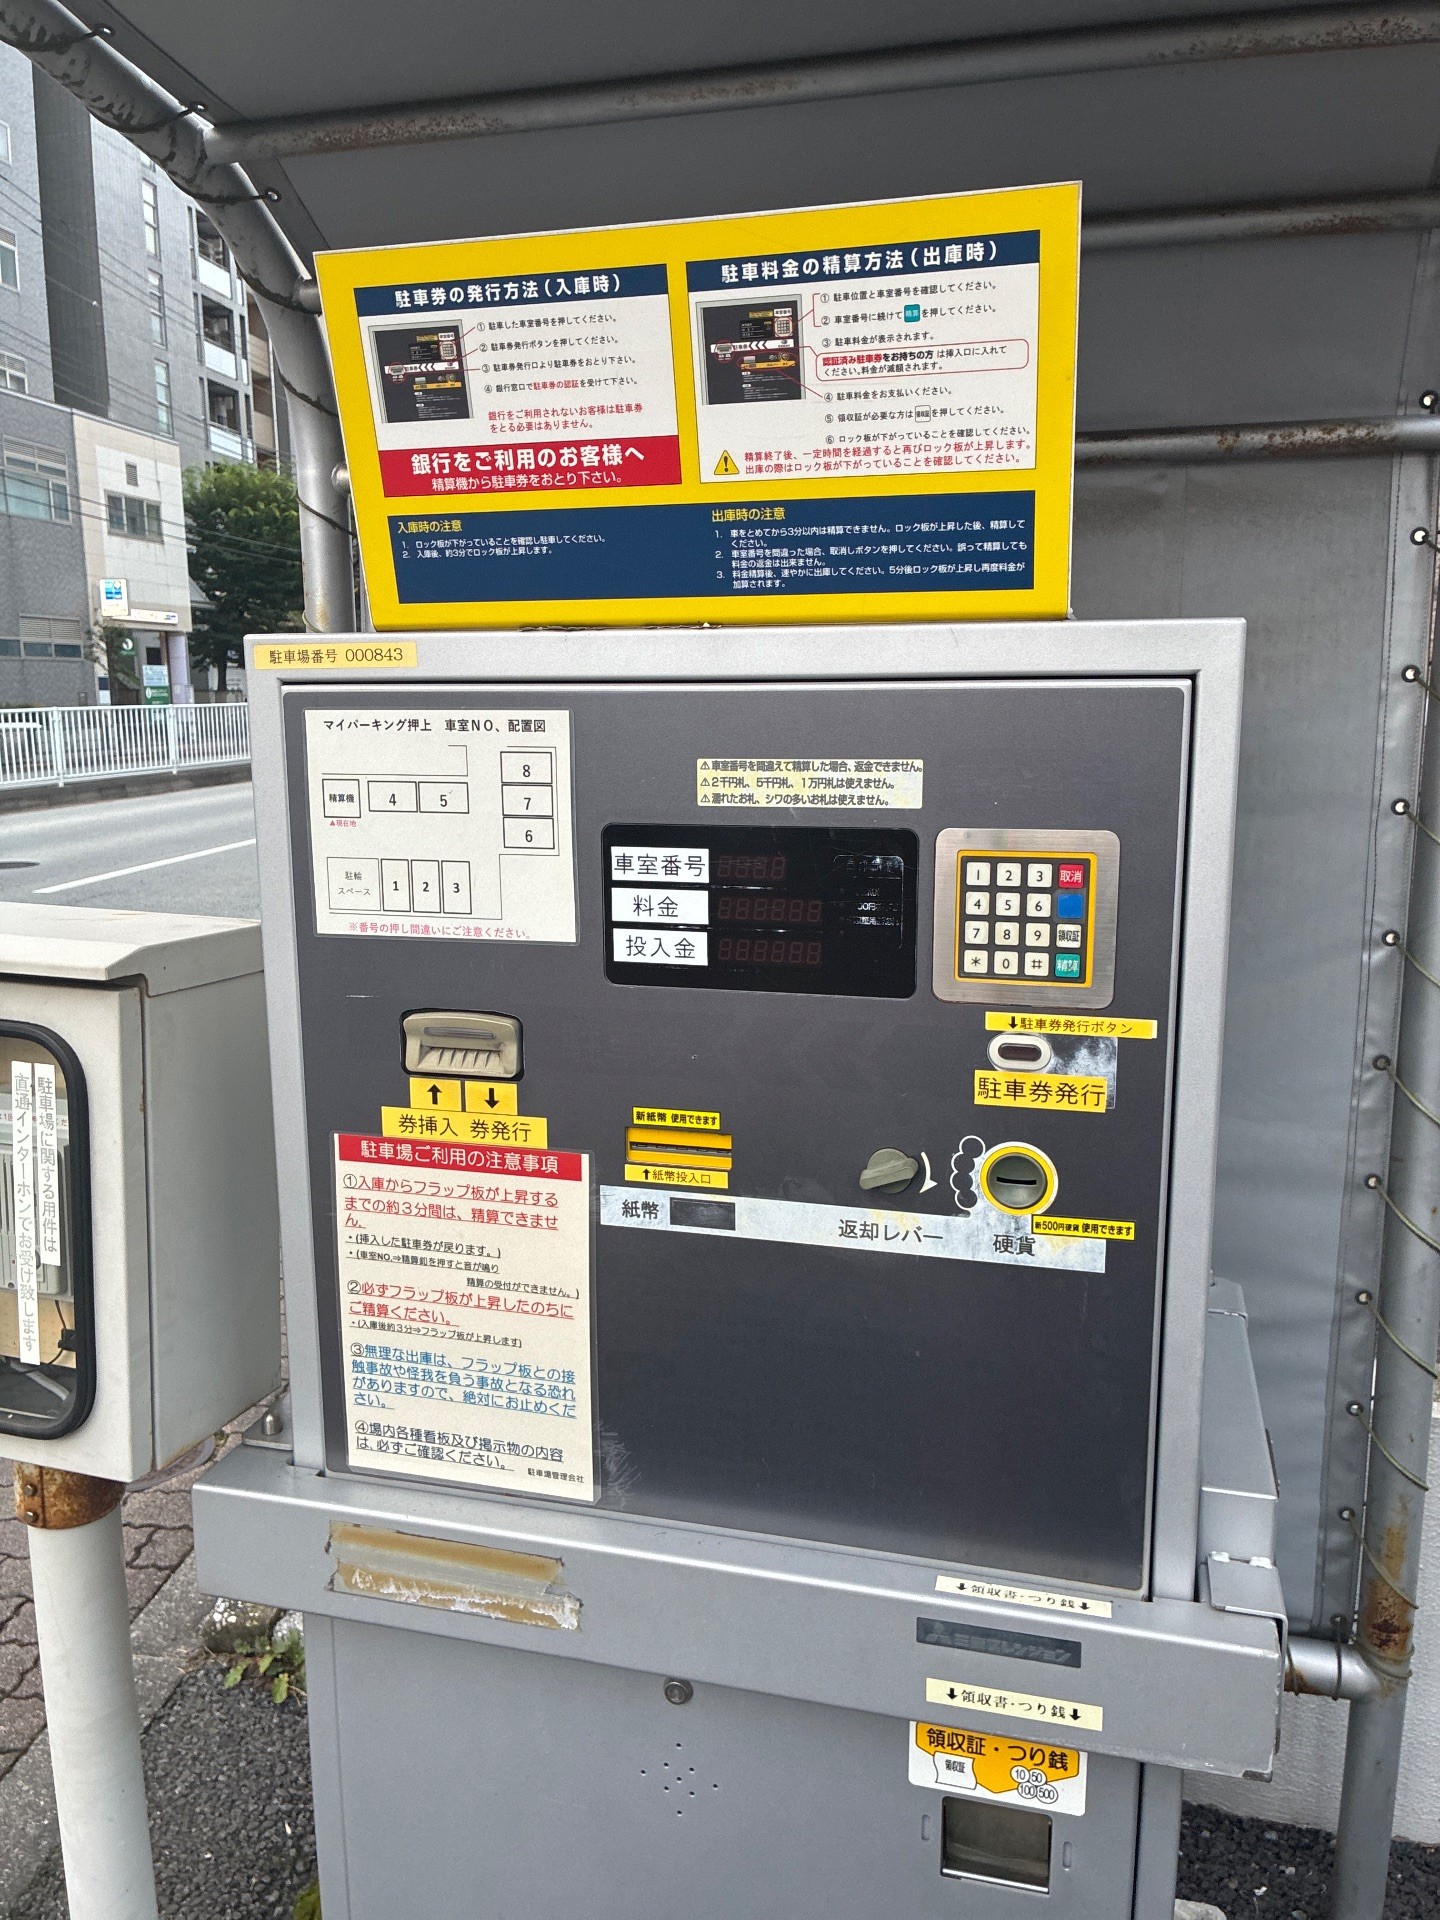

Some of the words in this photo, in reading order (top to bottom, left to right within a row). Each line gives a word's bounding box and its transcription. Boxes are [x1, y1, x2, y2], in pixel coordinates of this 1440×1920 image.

[721, 240, 999, 283] 駐車料金の精算方法(出庫時)
[394, 273, 621, 308] 駐車券の発行方法(入庫時)
[489, 419, 593, 433] をとる必要はありません。
[410, 444, 645, 475] 銀行をご利用のお客様へ
[431, 471, 622, 492] 精算機から駐車券をおとり下さい。
[711, 507, 785, 523] 出庫時の注意
[398, 520, 462, 533] 入庫時の注意
[269, 649, 337, 664] 駐車場番号
[345, 648, 403, 662] 000843
[323, 718, 432, 732] マイパーキング押上
[522, 765, 531, 778] 8
[328, 793, 355, 804] 精算機
[389, 794, 396, 806] 4
[440, 794, 448, 807] 5
[523, 797, 532, 810] 7
[525, 830, 533, 842] 6
[613, 853, 706, 877] 車室番号
[345, 871, 362, 881] 駐輪
[1005, 870, 1013, 881] 2
[1036, 871, 1043, 882] 3
[1059, 871, 1082, 883] 取消
[338, 887, 371, 896] スペース
[392, 880, 399, 891] 1
[422, 881, 430, 892] 2
[453, 882, 460, 893] 3
[632, 894, 679, 918] 料金
[974, 899, 982, 910] 4
[1004, 900, 1011, 911] 5
[1035, 901, 1042, 912] 6
[972, 928, 980, 939] 7
[1003, 929, 1011, 940] 8
[1034, 930, 1042, 941] 9
[625, 936, 696, 960] 投入金
[1002, 959, 1010, 969] 0
[1020, 1018, 1133, 1034] 駐車券発行ボタン
[977, 1077, 1105, 1107] 駐車券発行
[635, 1111, 666, 1123] 新紙幣
[670, 1113, 718, 1126] 使用できます
[398, 1114, 458, 1137] 券挿入
[470, 1119, 532, 1143] 券発行
[360, 1140, 559, 1174] 駐車場ご利用の注意事項
[38, 1076, 58, 1253] 駐車場に関する用件は
[652, 1168, 711, 1184] 紙幣投入口
[14, 1072, 36, 1351] 直通インターホンでお受け致します
[621, 1199, 659, 1220] 紙幣
[838, 1219, 944, 1243] 返却レバー
[1081, 1222, 1132, 1236] 使用できます
[992, 1234, 1036, 1256] 硬貨
[349, 1301, 452, 1325] ご精算ください。
[352, 1359, 576, 1401] 触事故や怪我を負う事故となる恐れ
[354, 1393, 388, 1408] さい。
[528, 1467, 585, 1483] 駐車場管理会社
[960, 1690, 1066, 1718] 領収書・つり銭
[926, 1728, 1068, 1772] 領収証・つり銭
[1015, 1769, 1025, 1780] 10
[1031, 1772, 1042, 1783] 50
[1020, 1785, 1035, 1796] 100
[1037, 1788, 1054, 1800] 500
